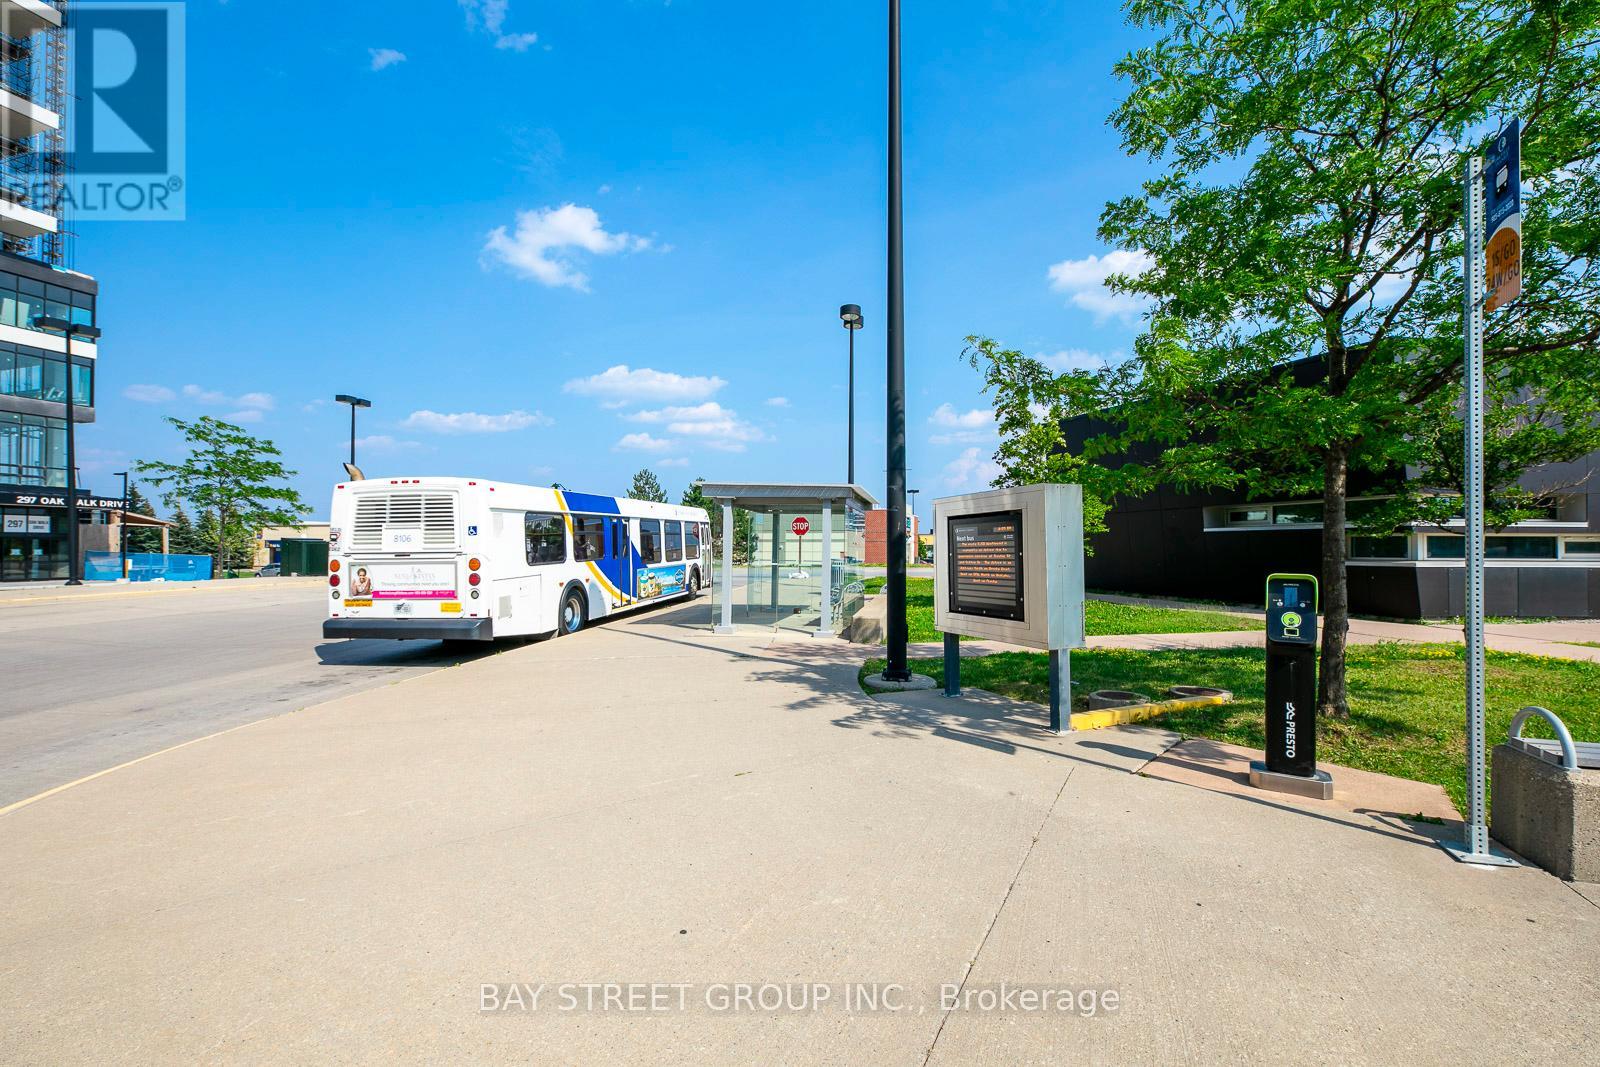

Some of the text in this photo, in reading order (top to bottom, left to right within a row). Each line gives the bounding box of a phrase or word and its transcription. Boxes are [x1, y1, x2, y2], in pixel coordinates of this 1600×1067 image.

[16, 496, 37, 504] 297
[40, 496, 65, 506] OAK
[7, 519, 24, 528] 297
[791, 521, 809, 531] STOP
[393, 534, 412, 543] 8106
[1285, 721, 1296, 759] PRESTO
